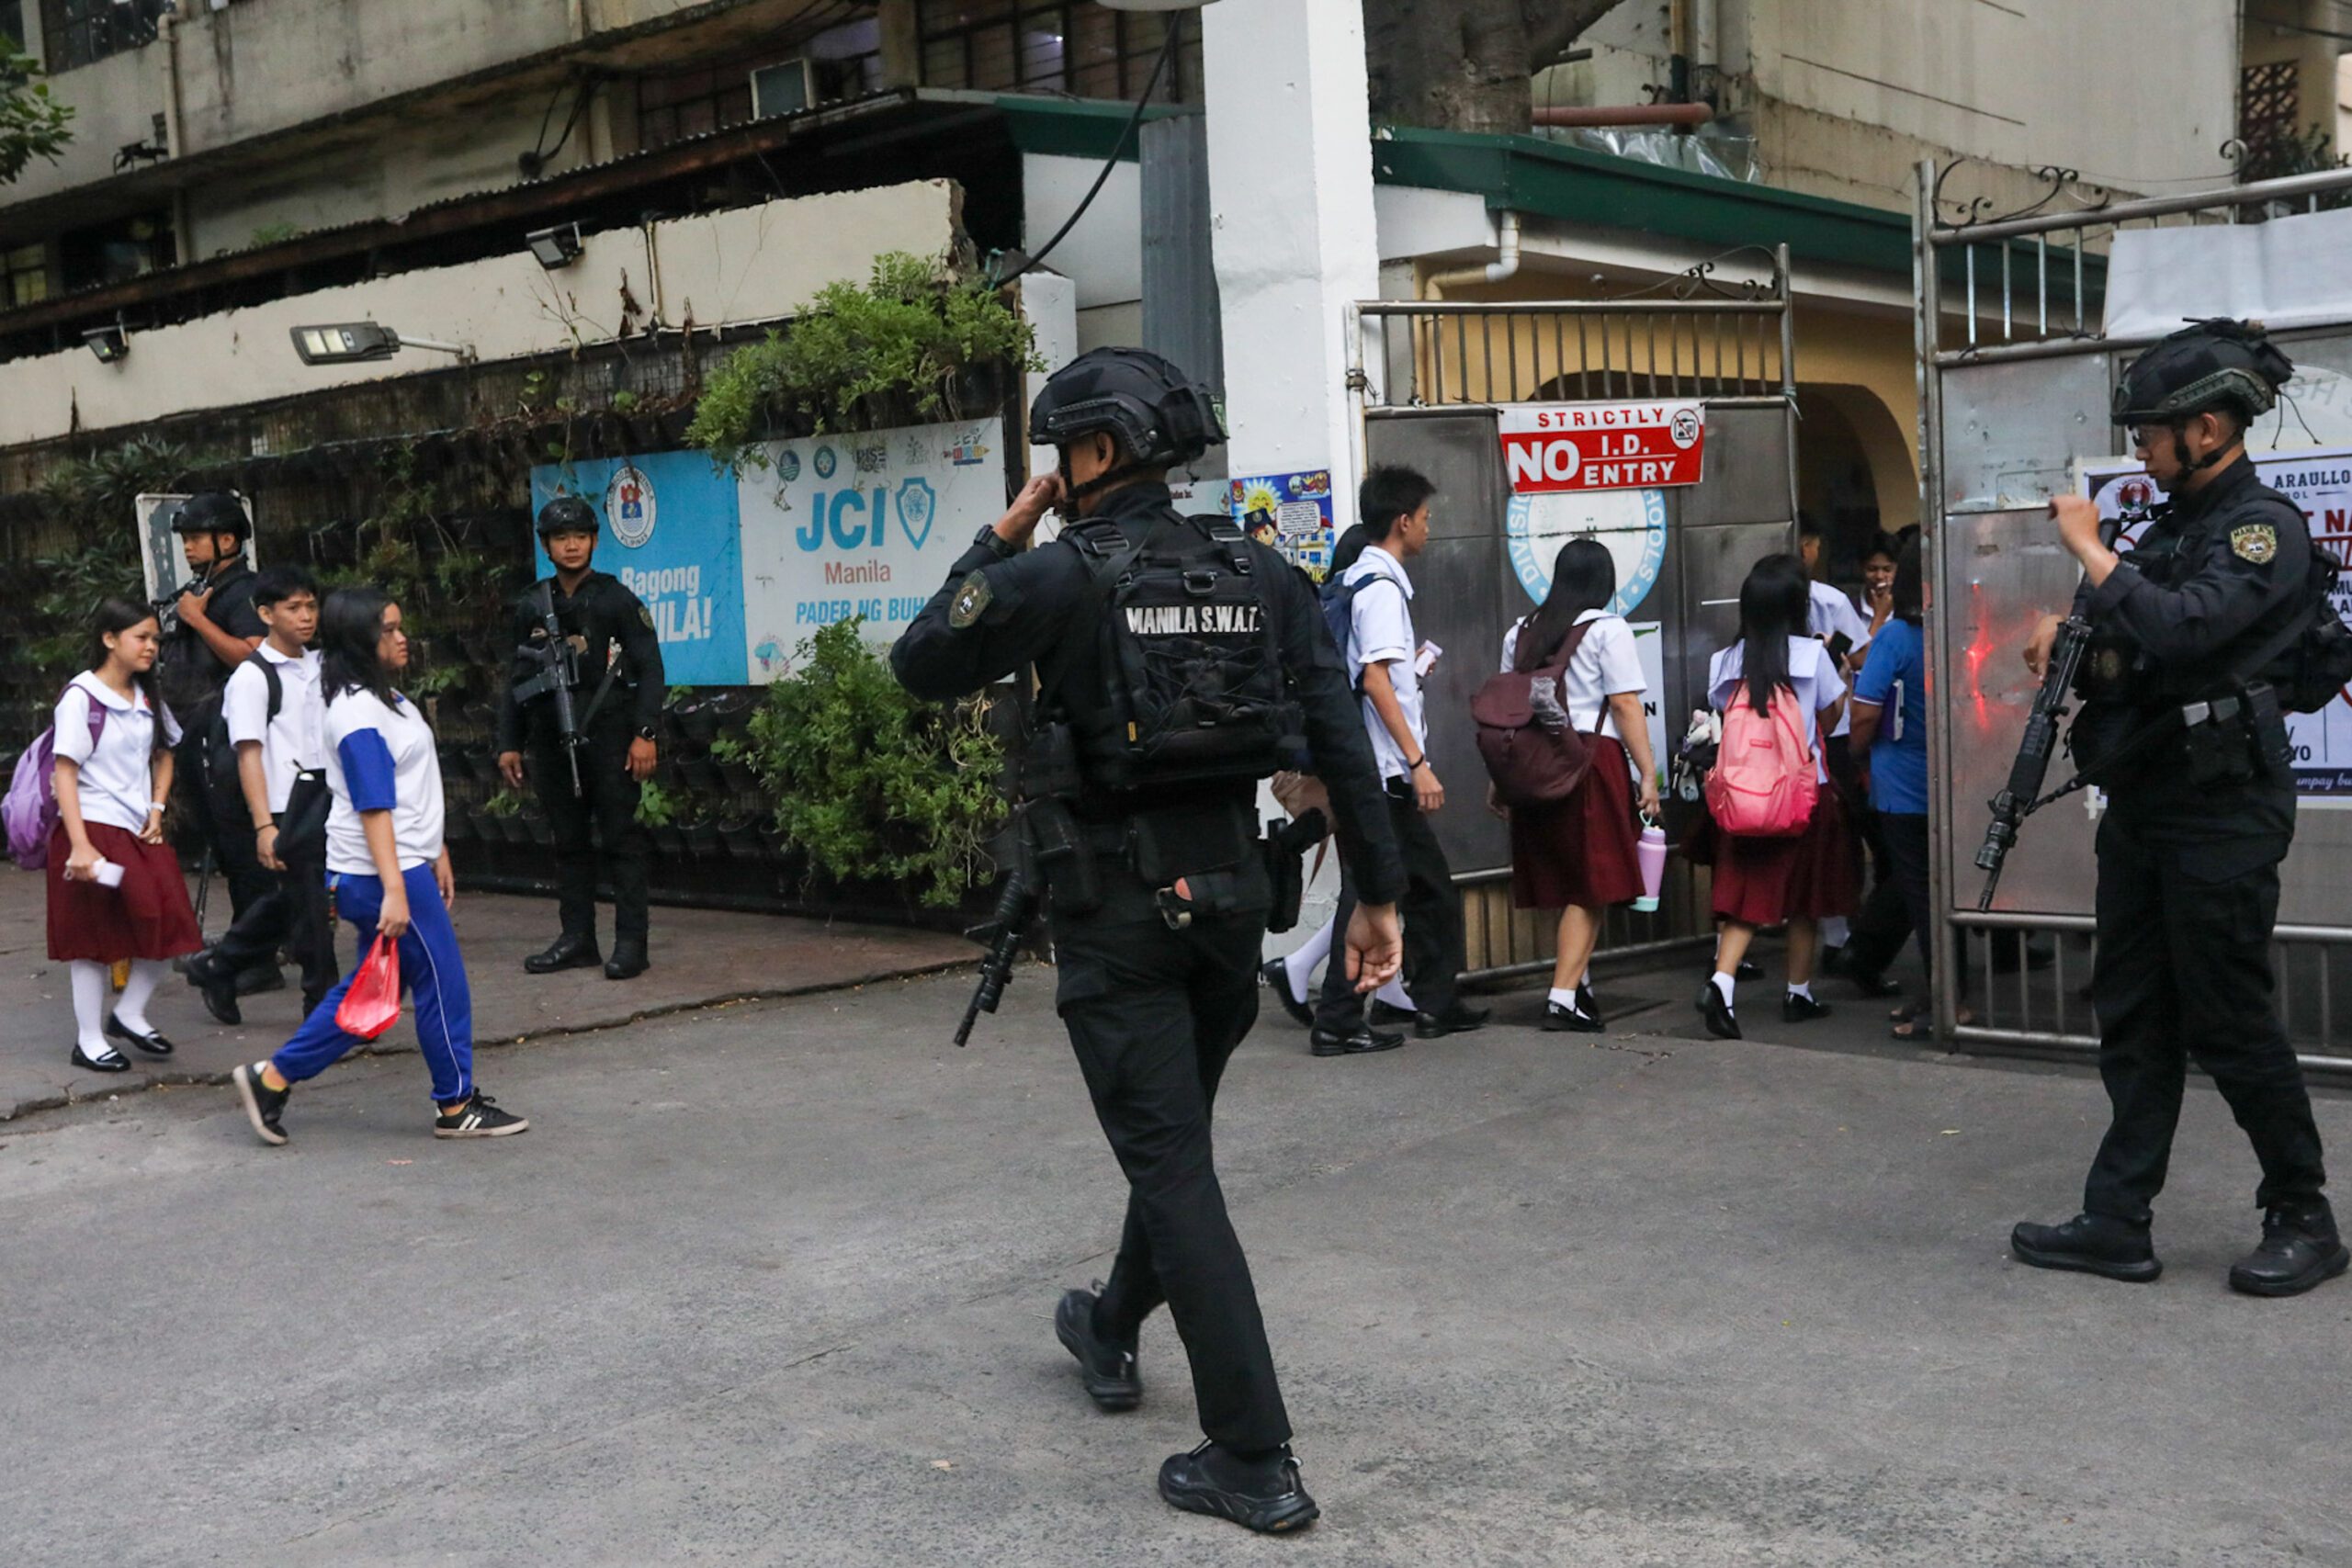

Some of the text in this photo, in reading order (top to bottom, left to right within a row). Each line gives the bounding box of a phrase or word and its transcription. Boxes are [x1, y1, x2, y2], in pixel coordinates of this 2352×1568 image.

[1538, 408, 1664, 427] STRICTLY
[1601, 434, 1649, 457] I.D.
[1508, 439, 1579, 482] NO
[1584, 461, 1675, 485] ENTRY
[2274, 470, 2350, 489] ARAULLO
[796, 488, 888, 553] JCI
[1638, 491, 1665, 582] HOOLS
[621, 565, 700, 602] Bagong
[824, 560, 891, 584] Manila
[858, 597, 882, 622] NG
[888, 595, 931, 621] BUH
[1126, 605, 1261, 635] MANILA S.W.A.T.
